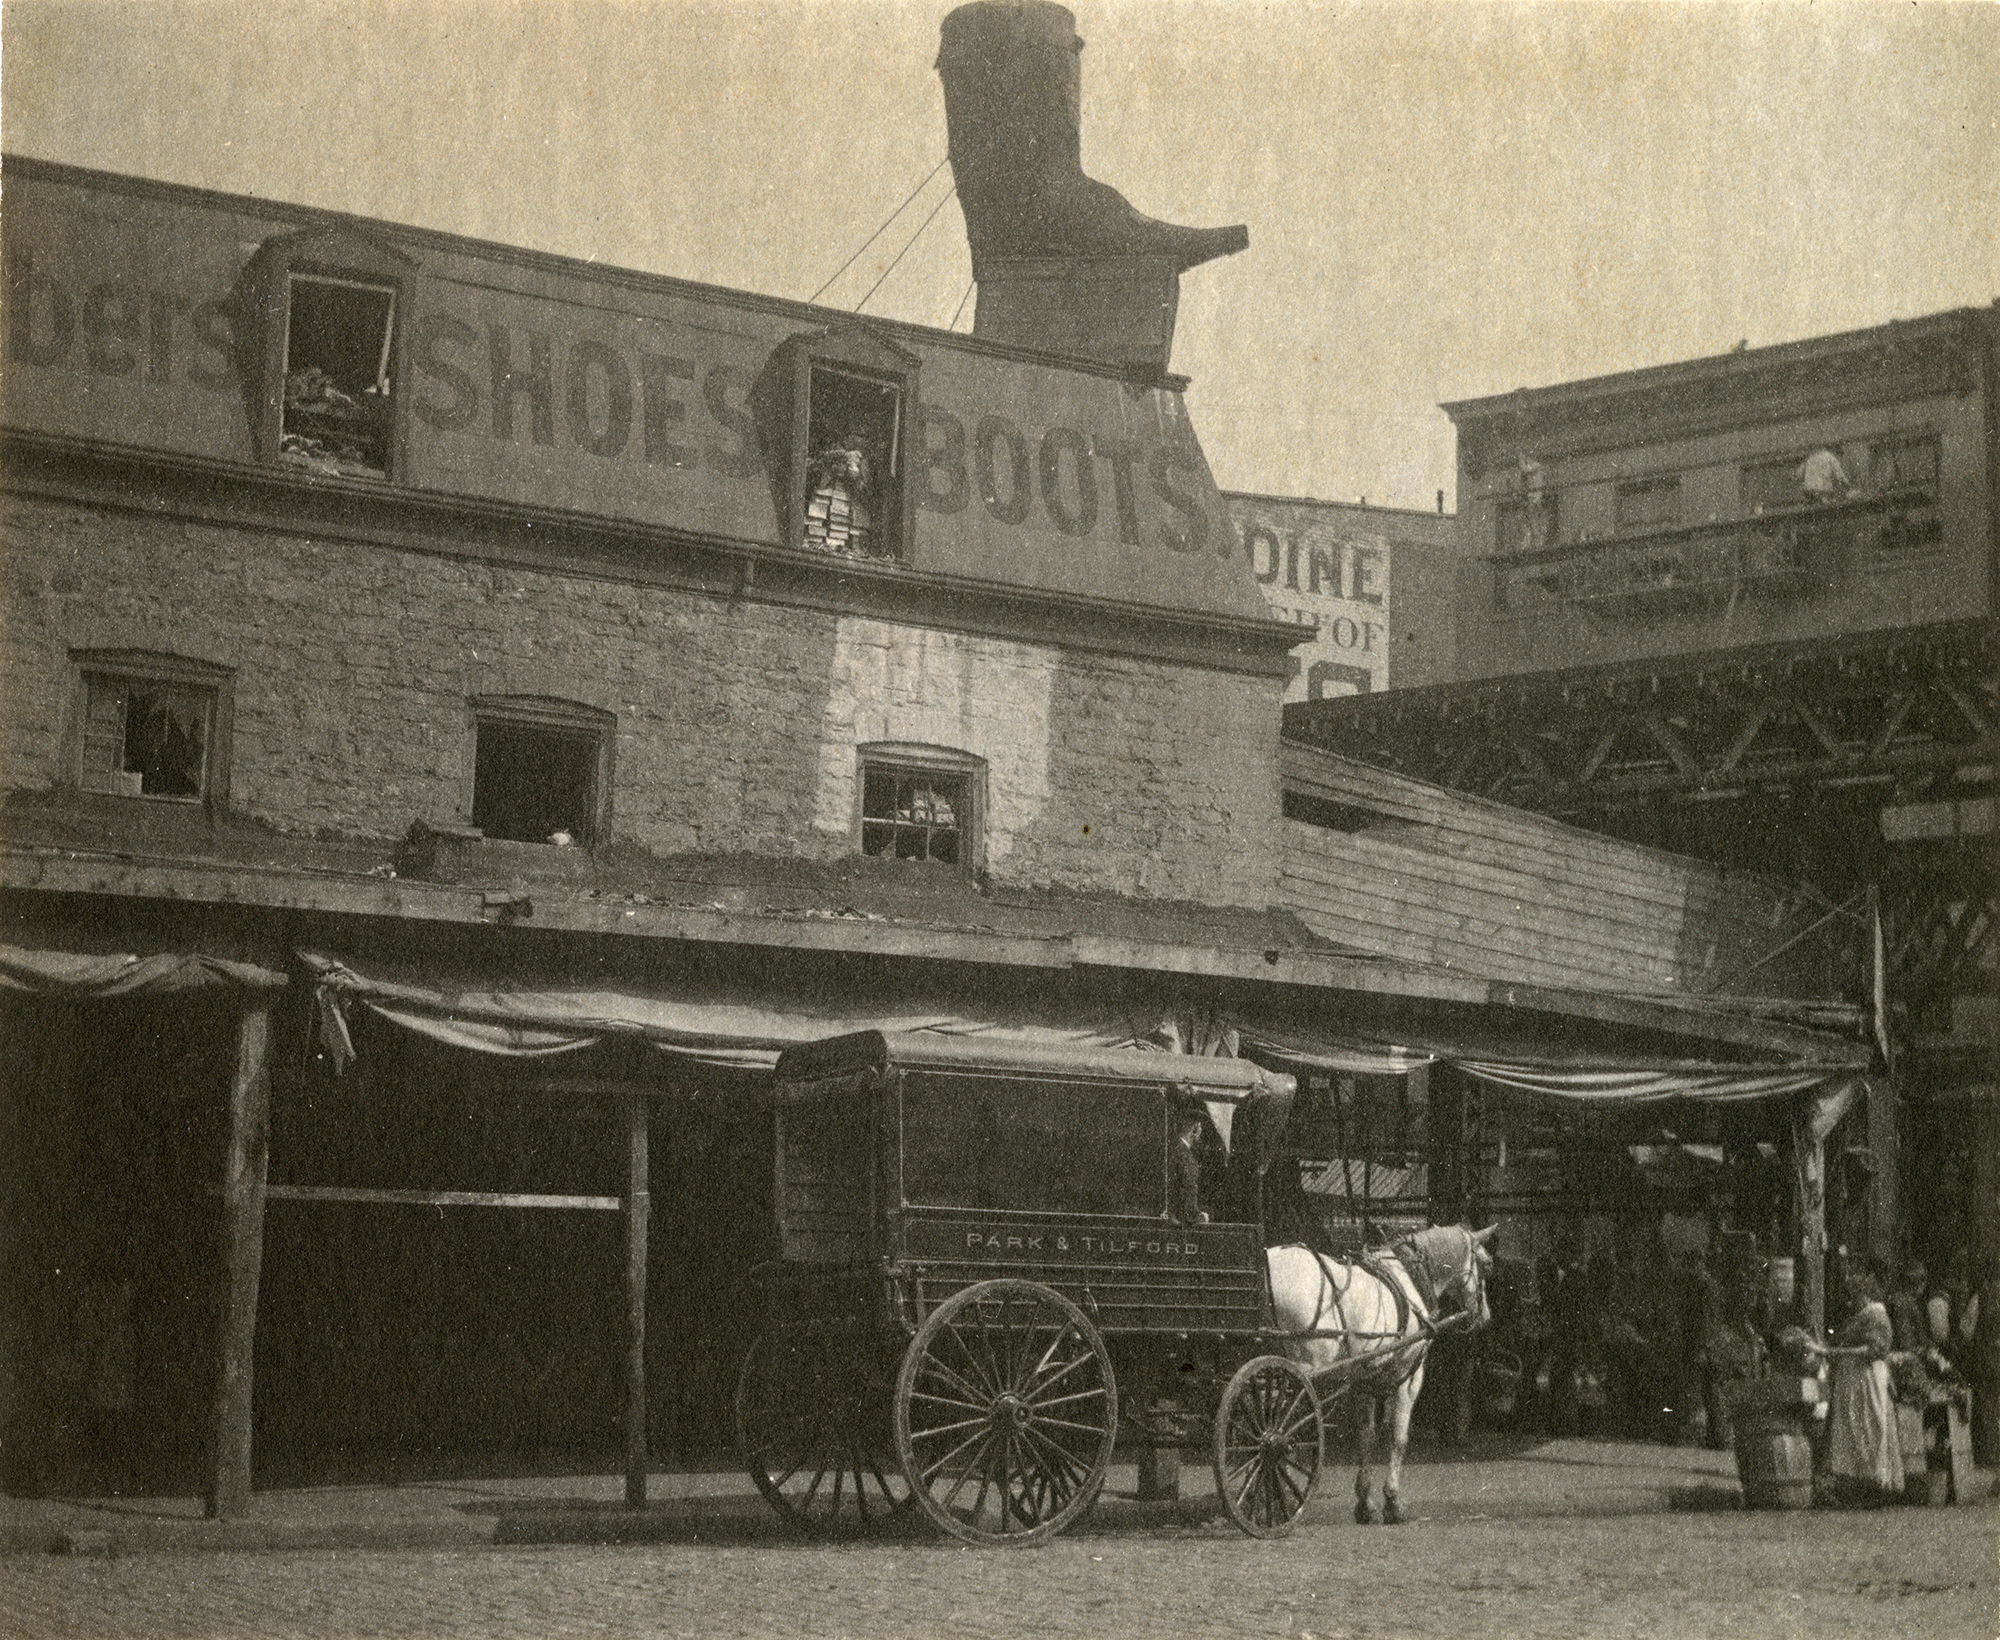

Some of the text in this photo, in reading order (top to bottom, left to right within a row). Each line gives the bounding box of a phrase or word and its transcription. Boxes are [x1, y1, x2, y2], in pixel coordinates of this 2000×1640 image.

[410, 311, 764, 478] SHOES
[966, 1233, 1199, 1255] PARK & TILFORD
